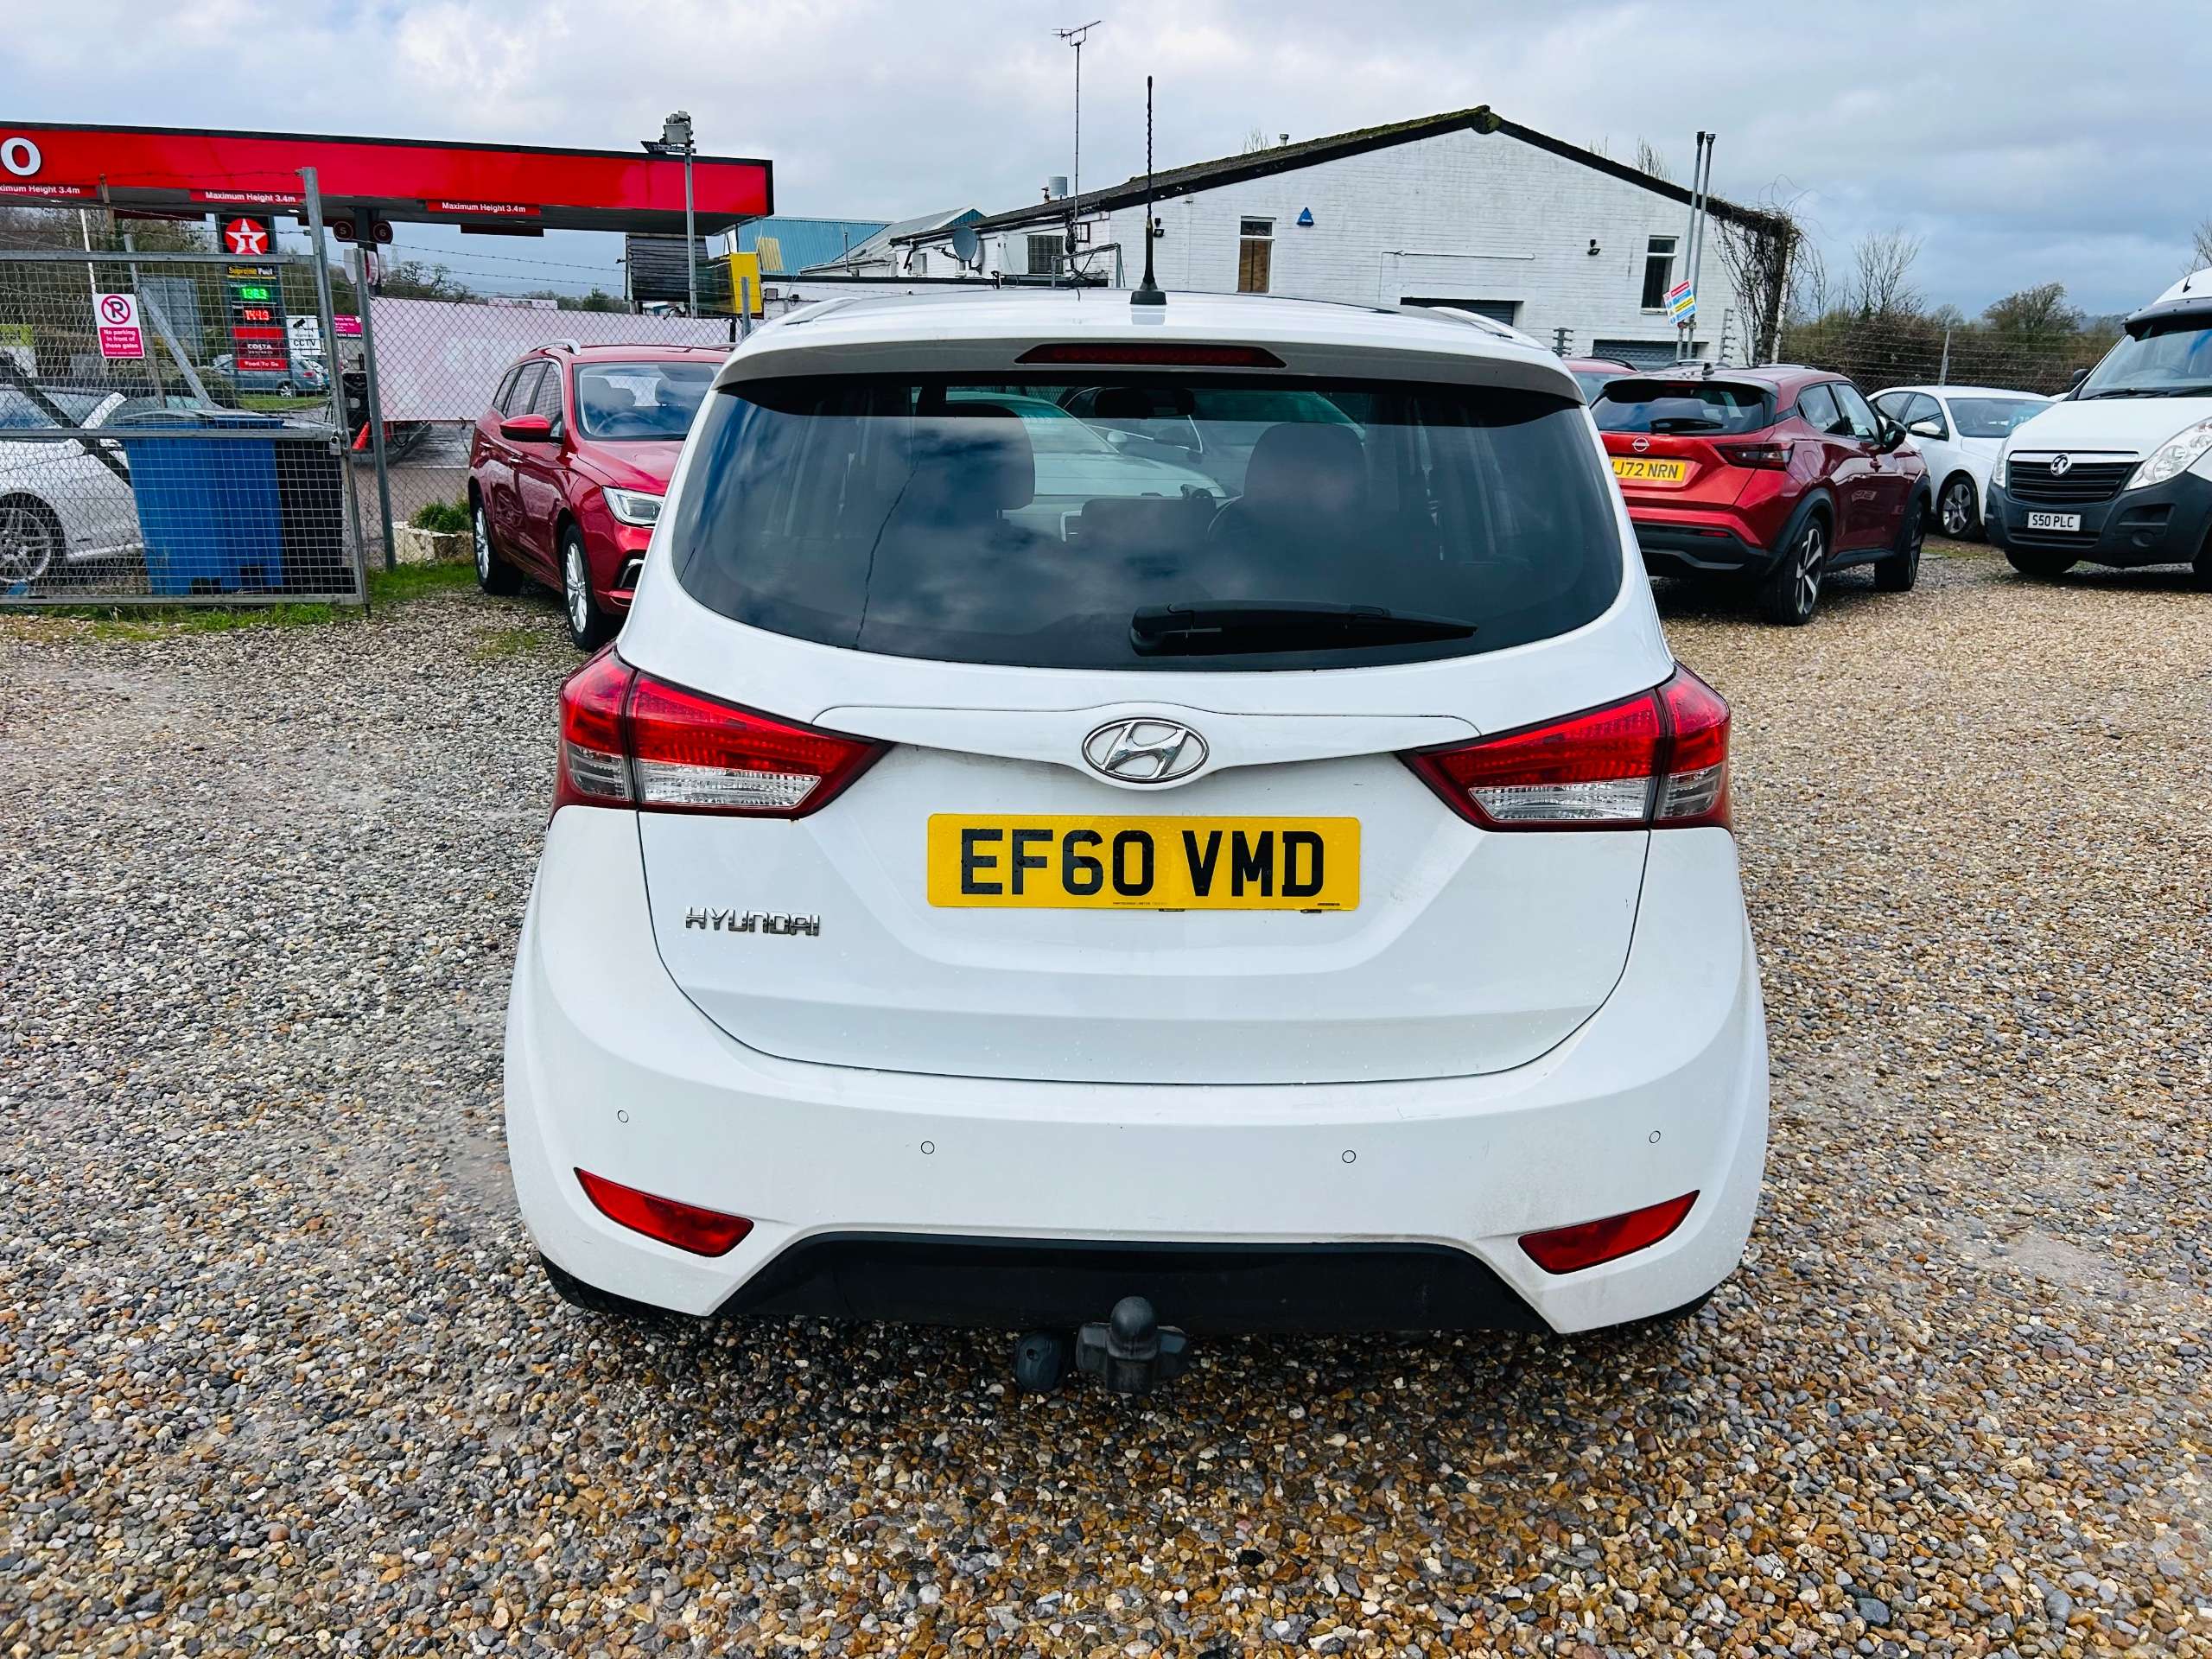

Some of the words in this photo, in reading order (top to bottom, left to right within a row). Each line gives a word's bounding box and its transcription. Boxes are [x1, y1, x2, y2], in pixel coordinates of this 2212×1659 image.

[29, 185, 57, 194] Height
[205, 191, 245, 200] Maximum
[246, 194, 274, 202] Height
[442, 201, 479, 210] Maximum
[480, 203, 505, 213] Height
[1647, 463, 1679, 479] NRN
[2032, 514, 2051, 526] S50
[2053, 515, 2074, 528] PLC
[960, 828, 1154, 897] EF60
[1180, 830, 1325, 897] VMD
[685, 906, 820, 937] HYUNDAI
